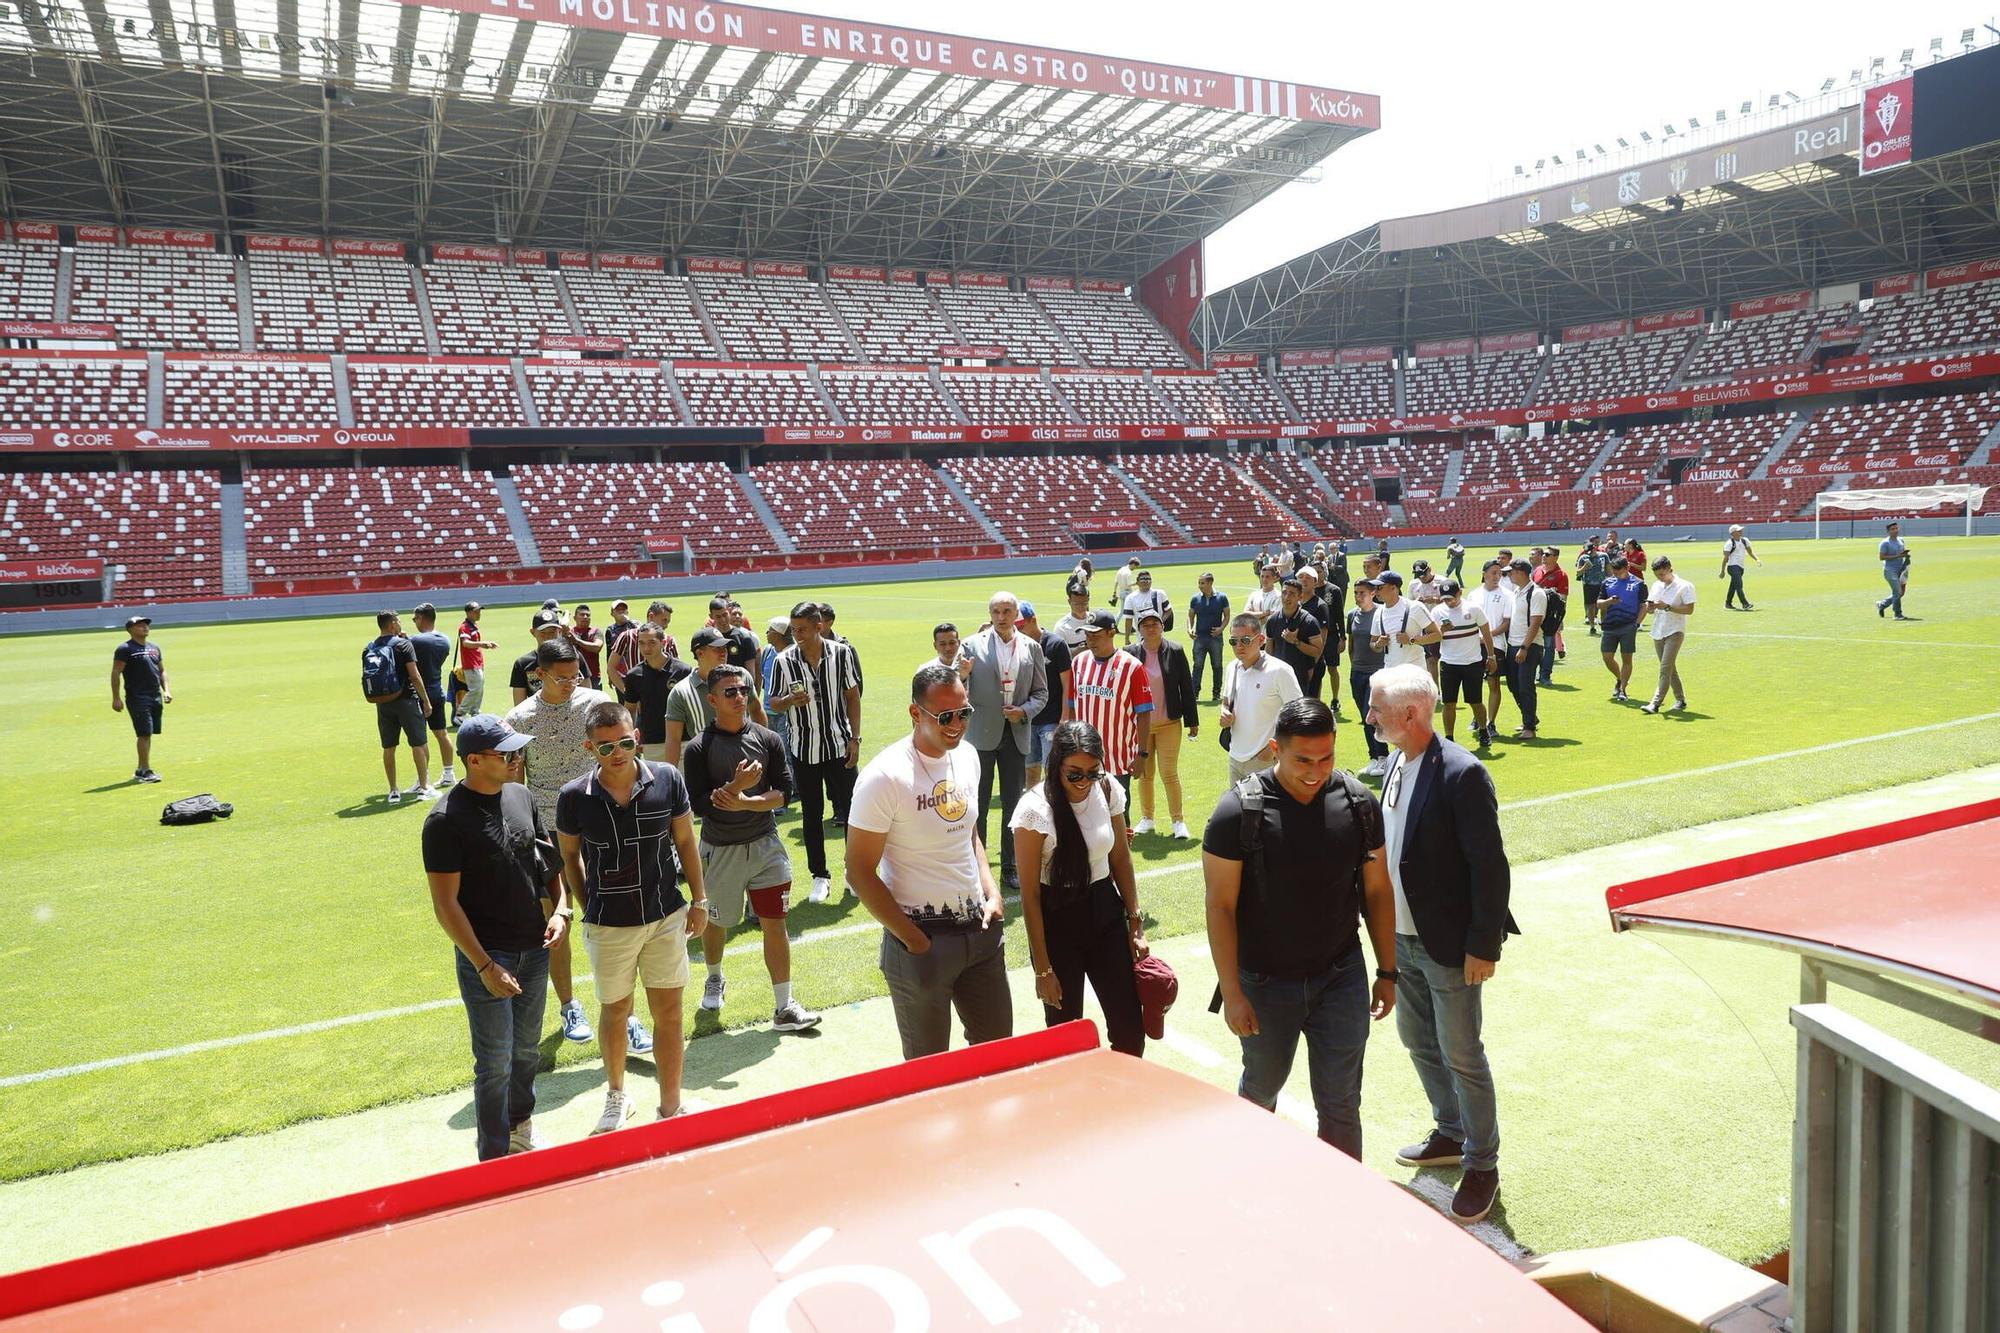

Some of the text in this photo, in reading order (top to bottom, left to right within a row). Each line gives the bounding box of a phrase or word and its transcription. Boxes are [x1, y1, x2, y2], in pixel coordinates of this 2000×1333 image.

[801, 25, 952, 64] ENRIQUE
[972, 48, 1088, 82] CASTRO
[1310, 93, 1363, 118] Xixón
[1794, 118, 1848, 154] Real
[1693, 389, 1750, 402] BELLAVISTA
[1033, 429, 1059, 439] alsa
[1093, 429, 1119, 439] alsa
[1184, 427, 1208, 438] PUMA
[1281, 427, 1308, 436] PUMA
[1337, 424, 1365, 434] PUMA
[74, 434, 112, 445] COPE
[231, 434, 320, 443] VITALDENT
[352, 433, 395, 442] VEOLIA
[912, 432, 945, 440] Mahou
[1688, 471, 1739, 481] ALIMERKA
[1408, 491, 1429, 499] PUMA
[33, 584, 83, 598] 1908
[1085, 686, 1114, 698] INTEGRA
[917, 791, 948, 811] Hard
